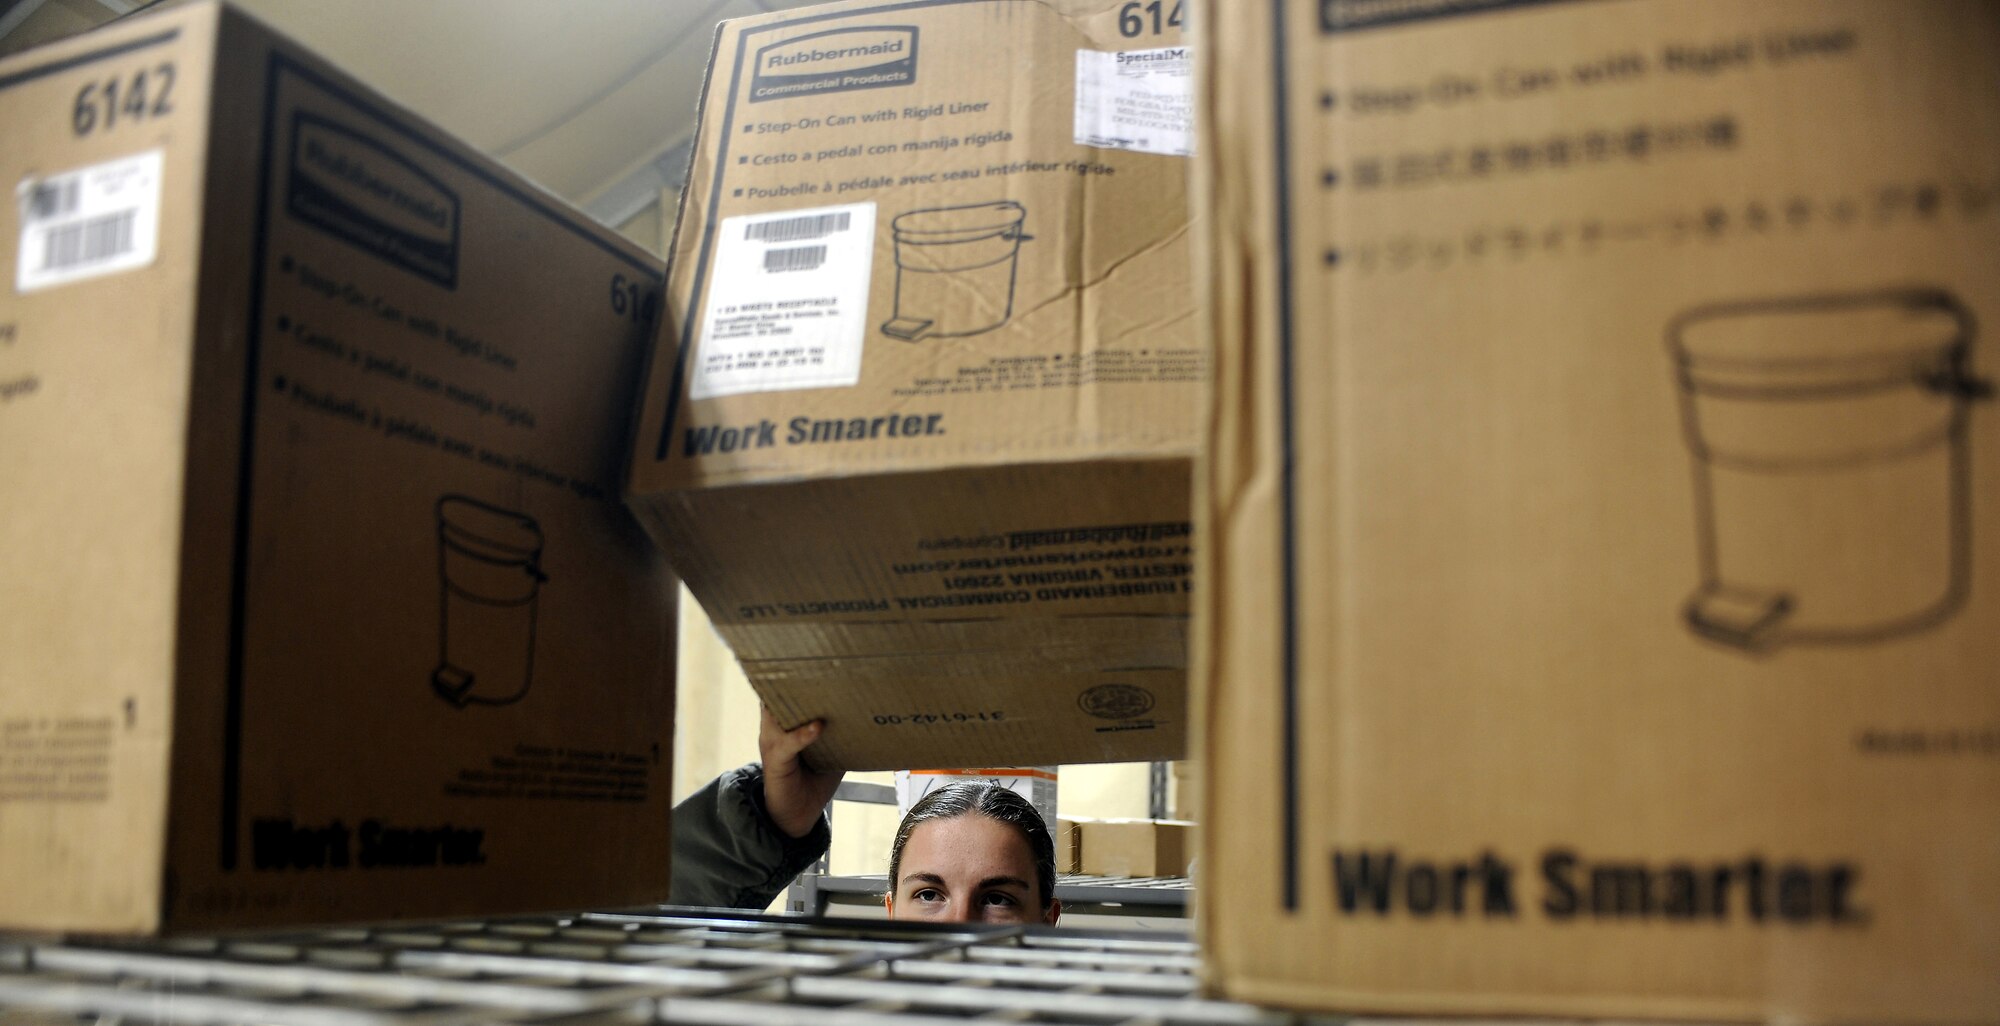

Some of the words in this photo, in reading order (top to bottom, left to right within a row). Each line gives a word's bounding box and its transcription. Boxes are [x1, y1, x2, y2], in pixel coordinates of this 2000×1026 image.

[767, 40, 903, 69] Rubbermaid
[756, 77, 839, 97] Commercial
[842, 71, 908, 87] Products
[72, 61, 177, 138] 6142
[757, 117, 821, 134] Step-On
[826, 114, 856, 127] Can
[862, 109, 898, 123] with
[902, 103, 944, 121] Rigid
[949, 101, 989, 114] Liner
[752, 152, 798, 166] Cesto
[802, 152, 812, 161] a
[817, 144, 862, 162] pedal
[867, 143, 897, 155] con
[902, 135, 959, 151] manija
[748, 182, 818, 200] Poubelle
[822, 180, 832, 193] à
[837, 174, 894, 194] pédale
[898, 171, 937, 185] avec
[941, 168, 980, 182] seau
[985, 158, 1061, 177] intérieur
[1064, 159, 1116, 177] rigide
[683, 420, 776, 458] Work
[786, 413, 945, 446] Smarter.
[917, 533, 1005, 549] Company
[942, 572, 1005, 590] 22601
[1008, 568, 1103, 587] VIRGINIA
[1036, 579, 1177, 602] RUBBERMAID
[740, 603, 778, 619] LLC
[778, 601, 889, 617] PRODUCTS,
[896, 589, 1031, 609] COMMERCIAL
[873, 710, 1005, 727] 31-6142-00
[252, 818, 350, 870] Work
[358, 818, 486, 869] Smarter.
[1330, 846, 1516, 920] Work
[1538, 846, 1871, 930] Smarter.
